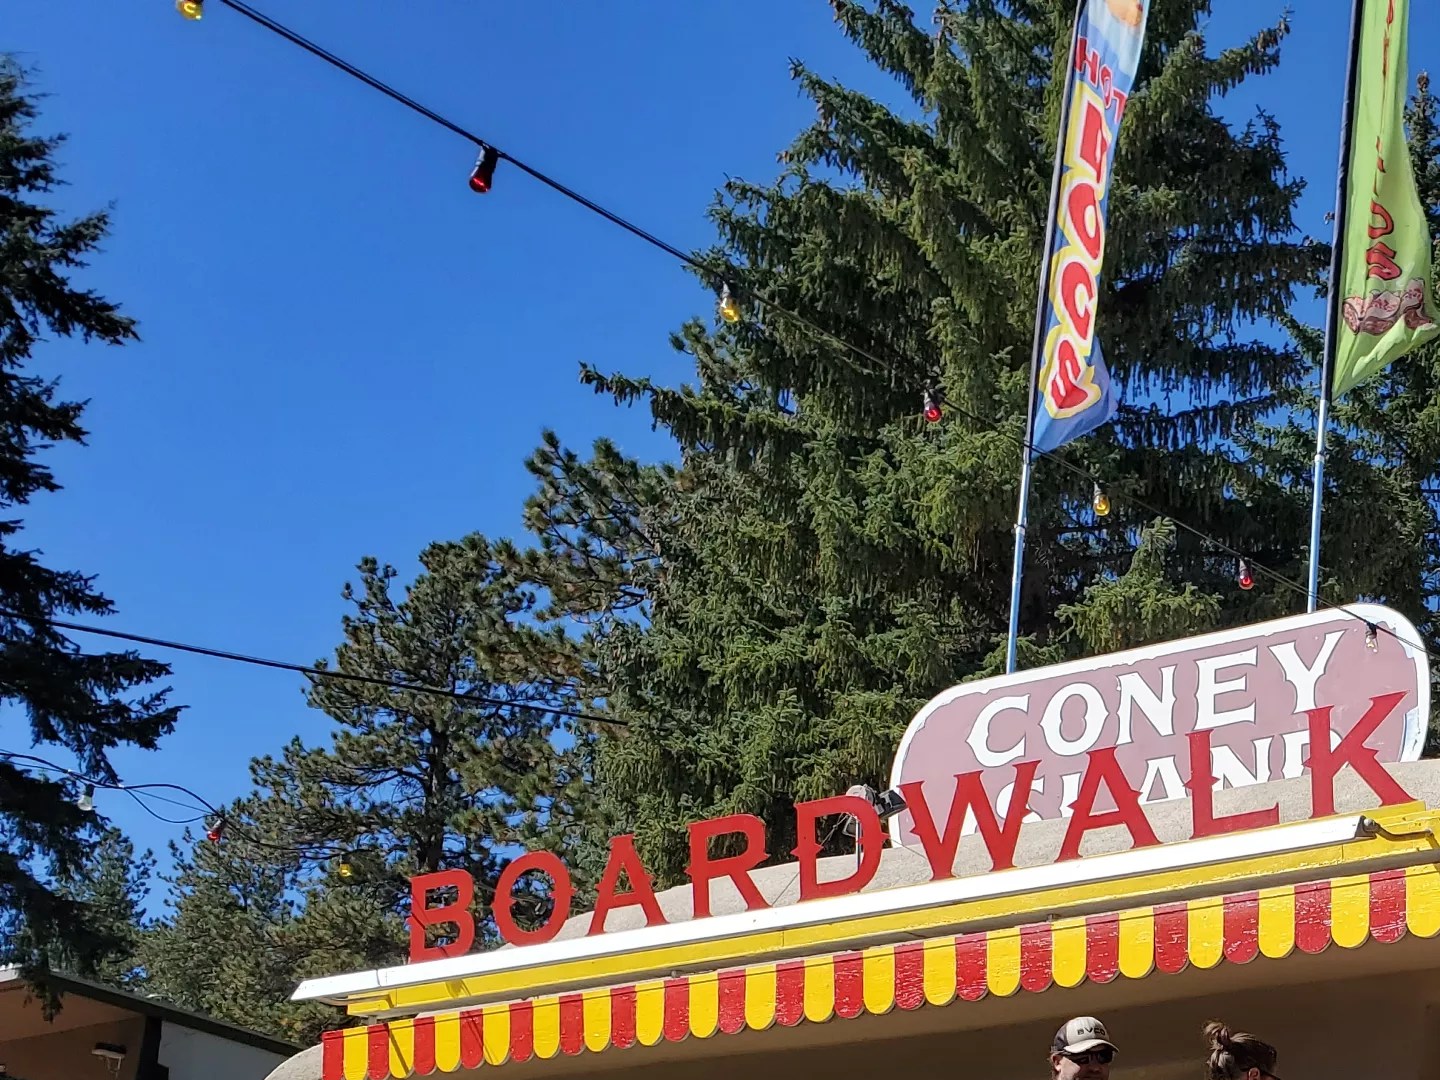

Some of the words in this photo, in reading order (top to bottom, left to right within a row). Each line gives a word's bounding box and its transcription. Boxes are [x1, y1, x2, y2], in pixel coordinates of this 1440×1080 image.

[1075, 36, 1128, 124] HOT
[966, 629, 1346, 768] CONEY
[407, 689, 1417, 963] BOARDWALK
